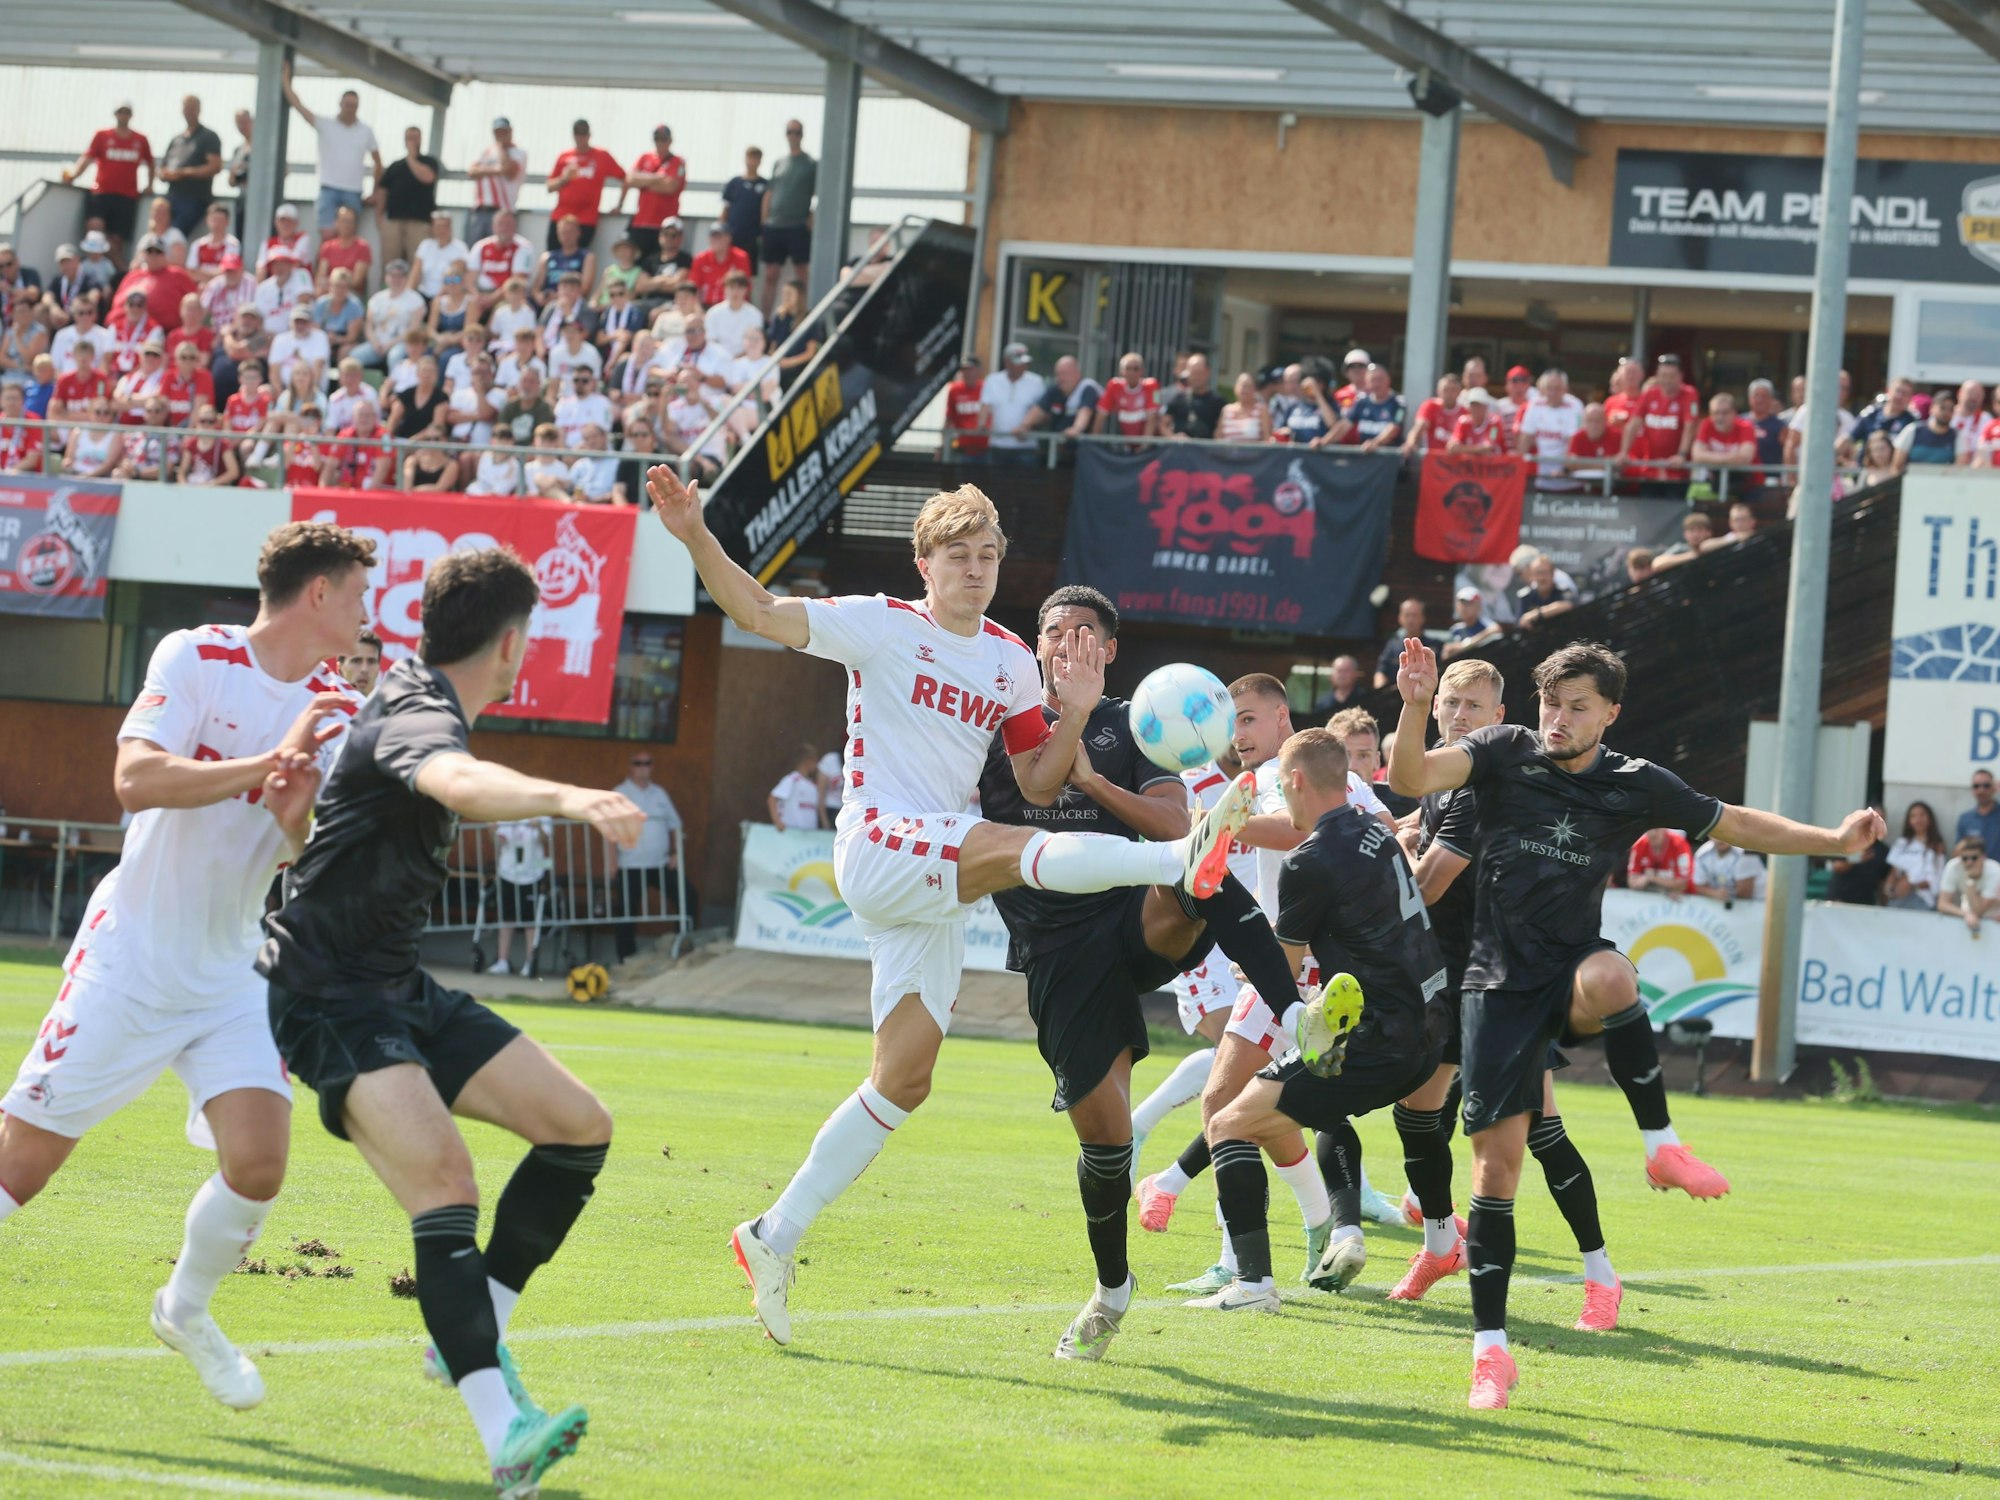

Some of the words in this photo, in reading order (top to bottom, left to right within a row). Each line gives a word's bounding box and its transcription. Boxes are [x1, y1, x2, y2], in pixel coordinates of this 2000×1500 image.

[1631, 185, 1766, 222] TEAM
[1781, 192, 1942, 230] PNDL
[1028, 271, 1066, 326] K
[744, 450, 824, 554] THALLER
[824, 388, 877, 467] KRAN
[1152, 550, 1210, 572] IMMER
[1118, 587, 1303, 625] www.fans1991.de
[911, 674, 1009, 732] REWE
[1023, 809, 1098, 821] WESTACRES
[1520, 839, 1592, 867] WESTACRES
[1392, 853, 1431, 931] 4
[1801, 959, 1887, 1011] Bad
[1900, 968, 2000, 1023] Walt
